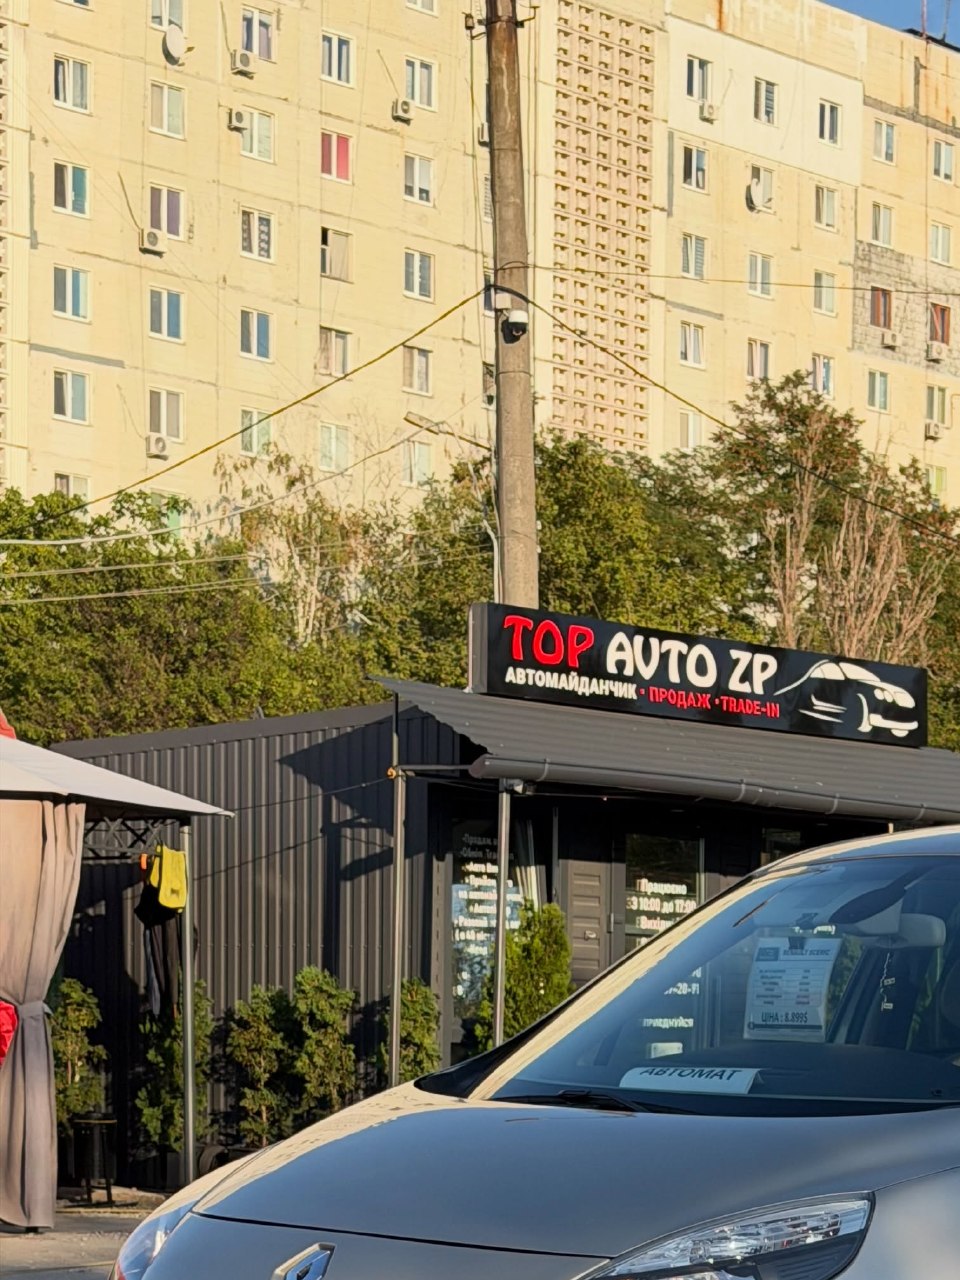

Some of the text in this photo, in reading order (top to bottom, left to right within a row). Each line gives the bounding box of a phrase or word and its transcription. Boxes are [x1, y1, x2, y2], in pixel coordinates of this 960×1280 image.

[503, 614, 595, 668] TOP
[728, 649, 778, 696] ZP
[505, 666, 780, 718] АВТОМАЙДАНЧИК ПРОДАЖ TRADE-IN
[640, 1068, 742, 1081] АВТОМАТ
